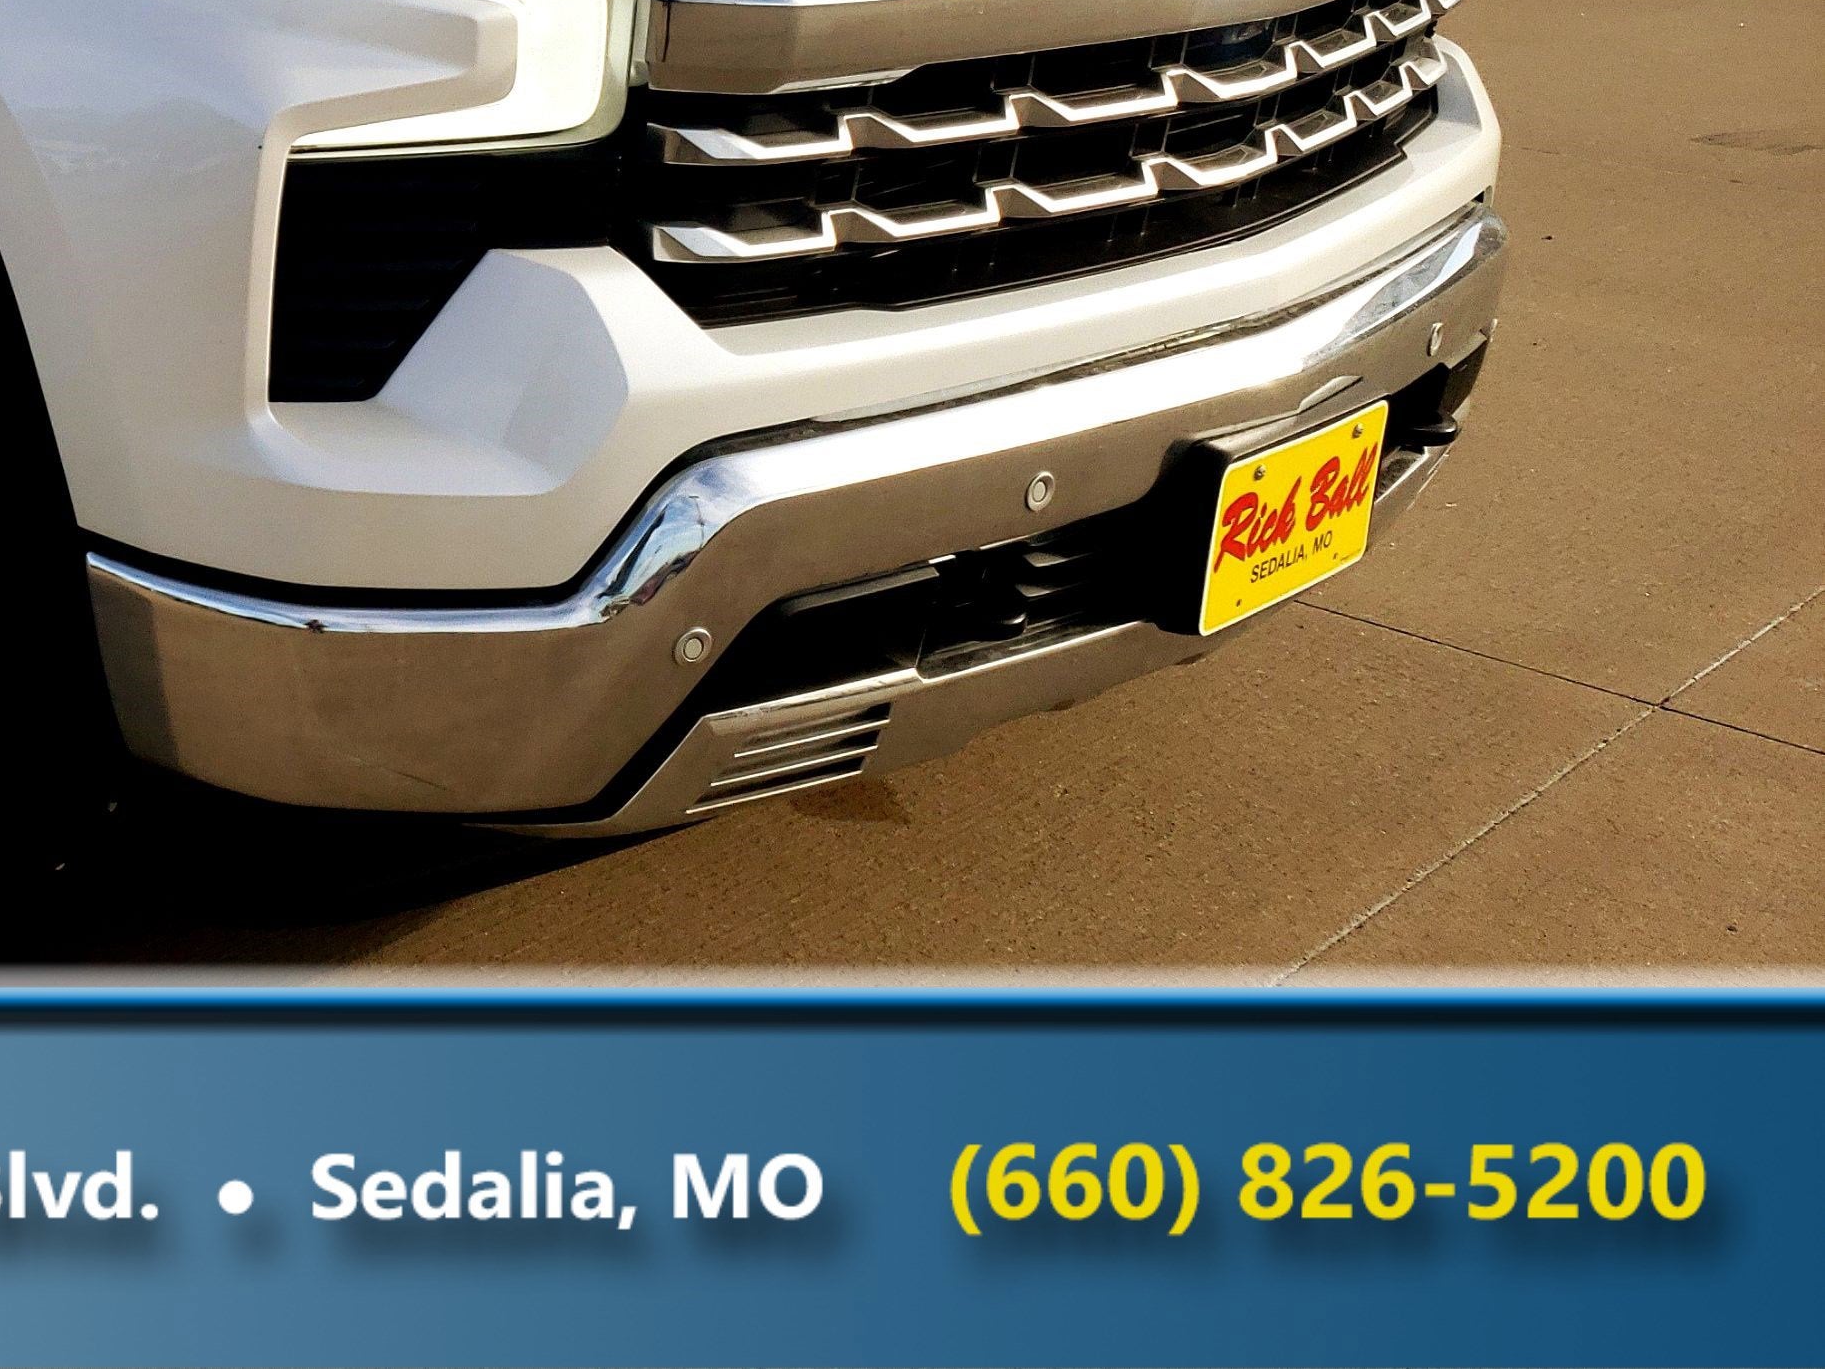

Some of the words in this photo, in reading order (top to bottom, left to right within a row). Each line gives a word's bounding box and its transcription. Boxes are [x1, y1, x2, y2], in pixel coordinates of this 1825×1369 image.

[1213, 476, 1302, 573] Rick
[1305, 441, 1378, 531] Ball
[1249, 545, 1308, 584] SEDALIA,
[1313, 529, 1333, 554] MO
